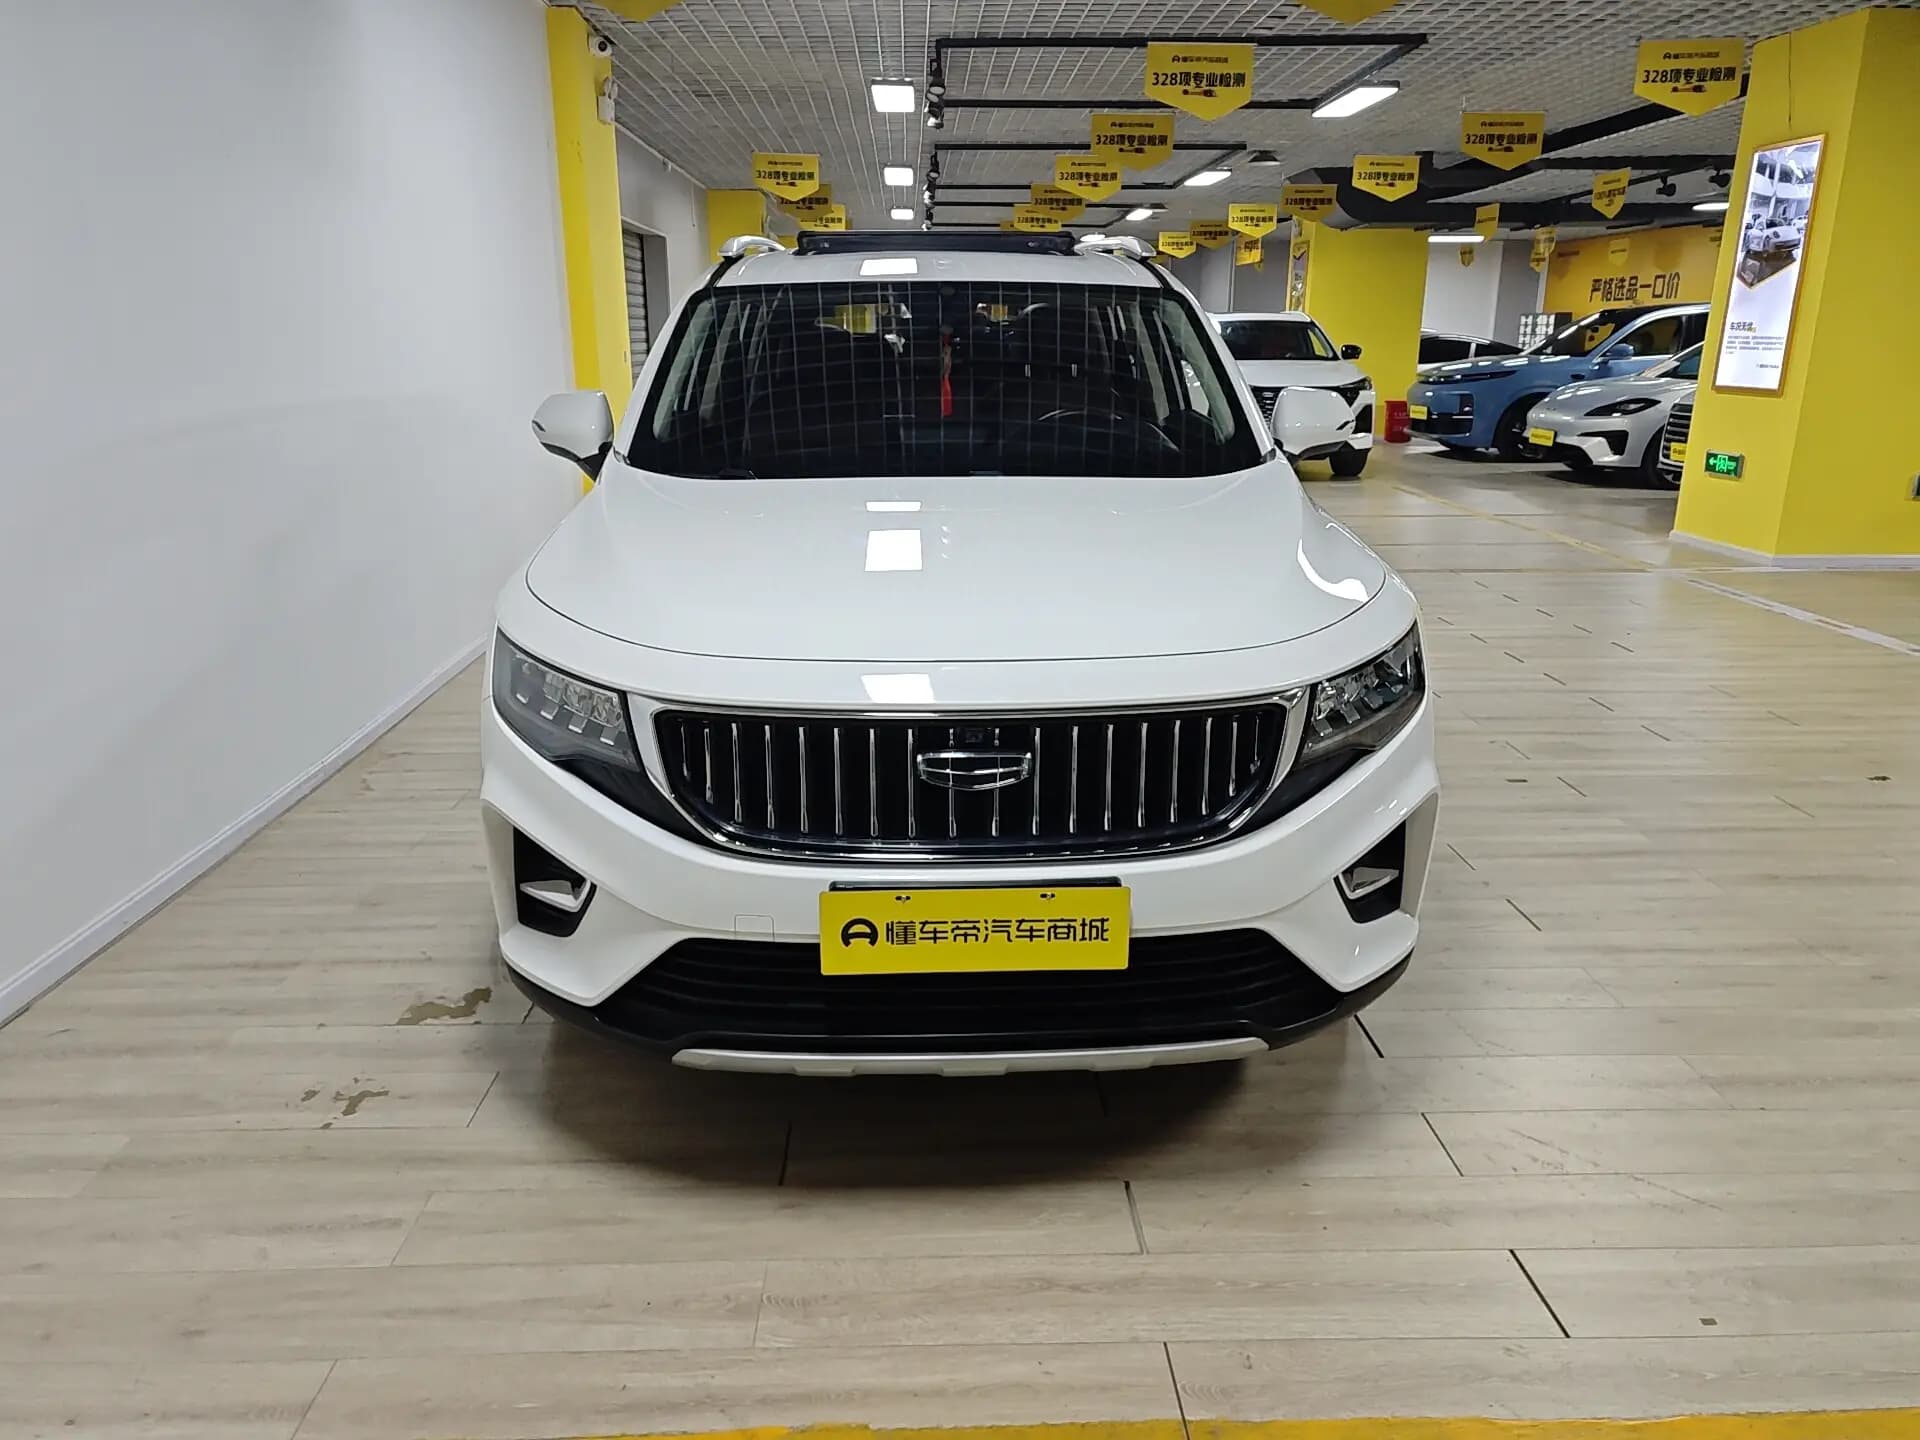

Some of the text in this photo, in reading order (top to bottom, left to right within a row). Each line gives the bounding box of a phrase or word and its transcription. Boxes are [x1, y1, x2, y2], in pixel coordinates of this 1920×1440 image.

[1152, 72, 1246, 88] 328项专业检测
[1642, 66, 1736, 84] 328项专业检测
[1095, 134, 1168, 147] 328项专业检测
[1464, 133, 1537, 146] 328项专业检测
[1589, 271, 1681, 303] 严格选品一口价
[885, 918, 1110, 945] 懂车帝汽车商城
